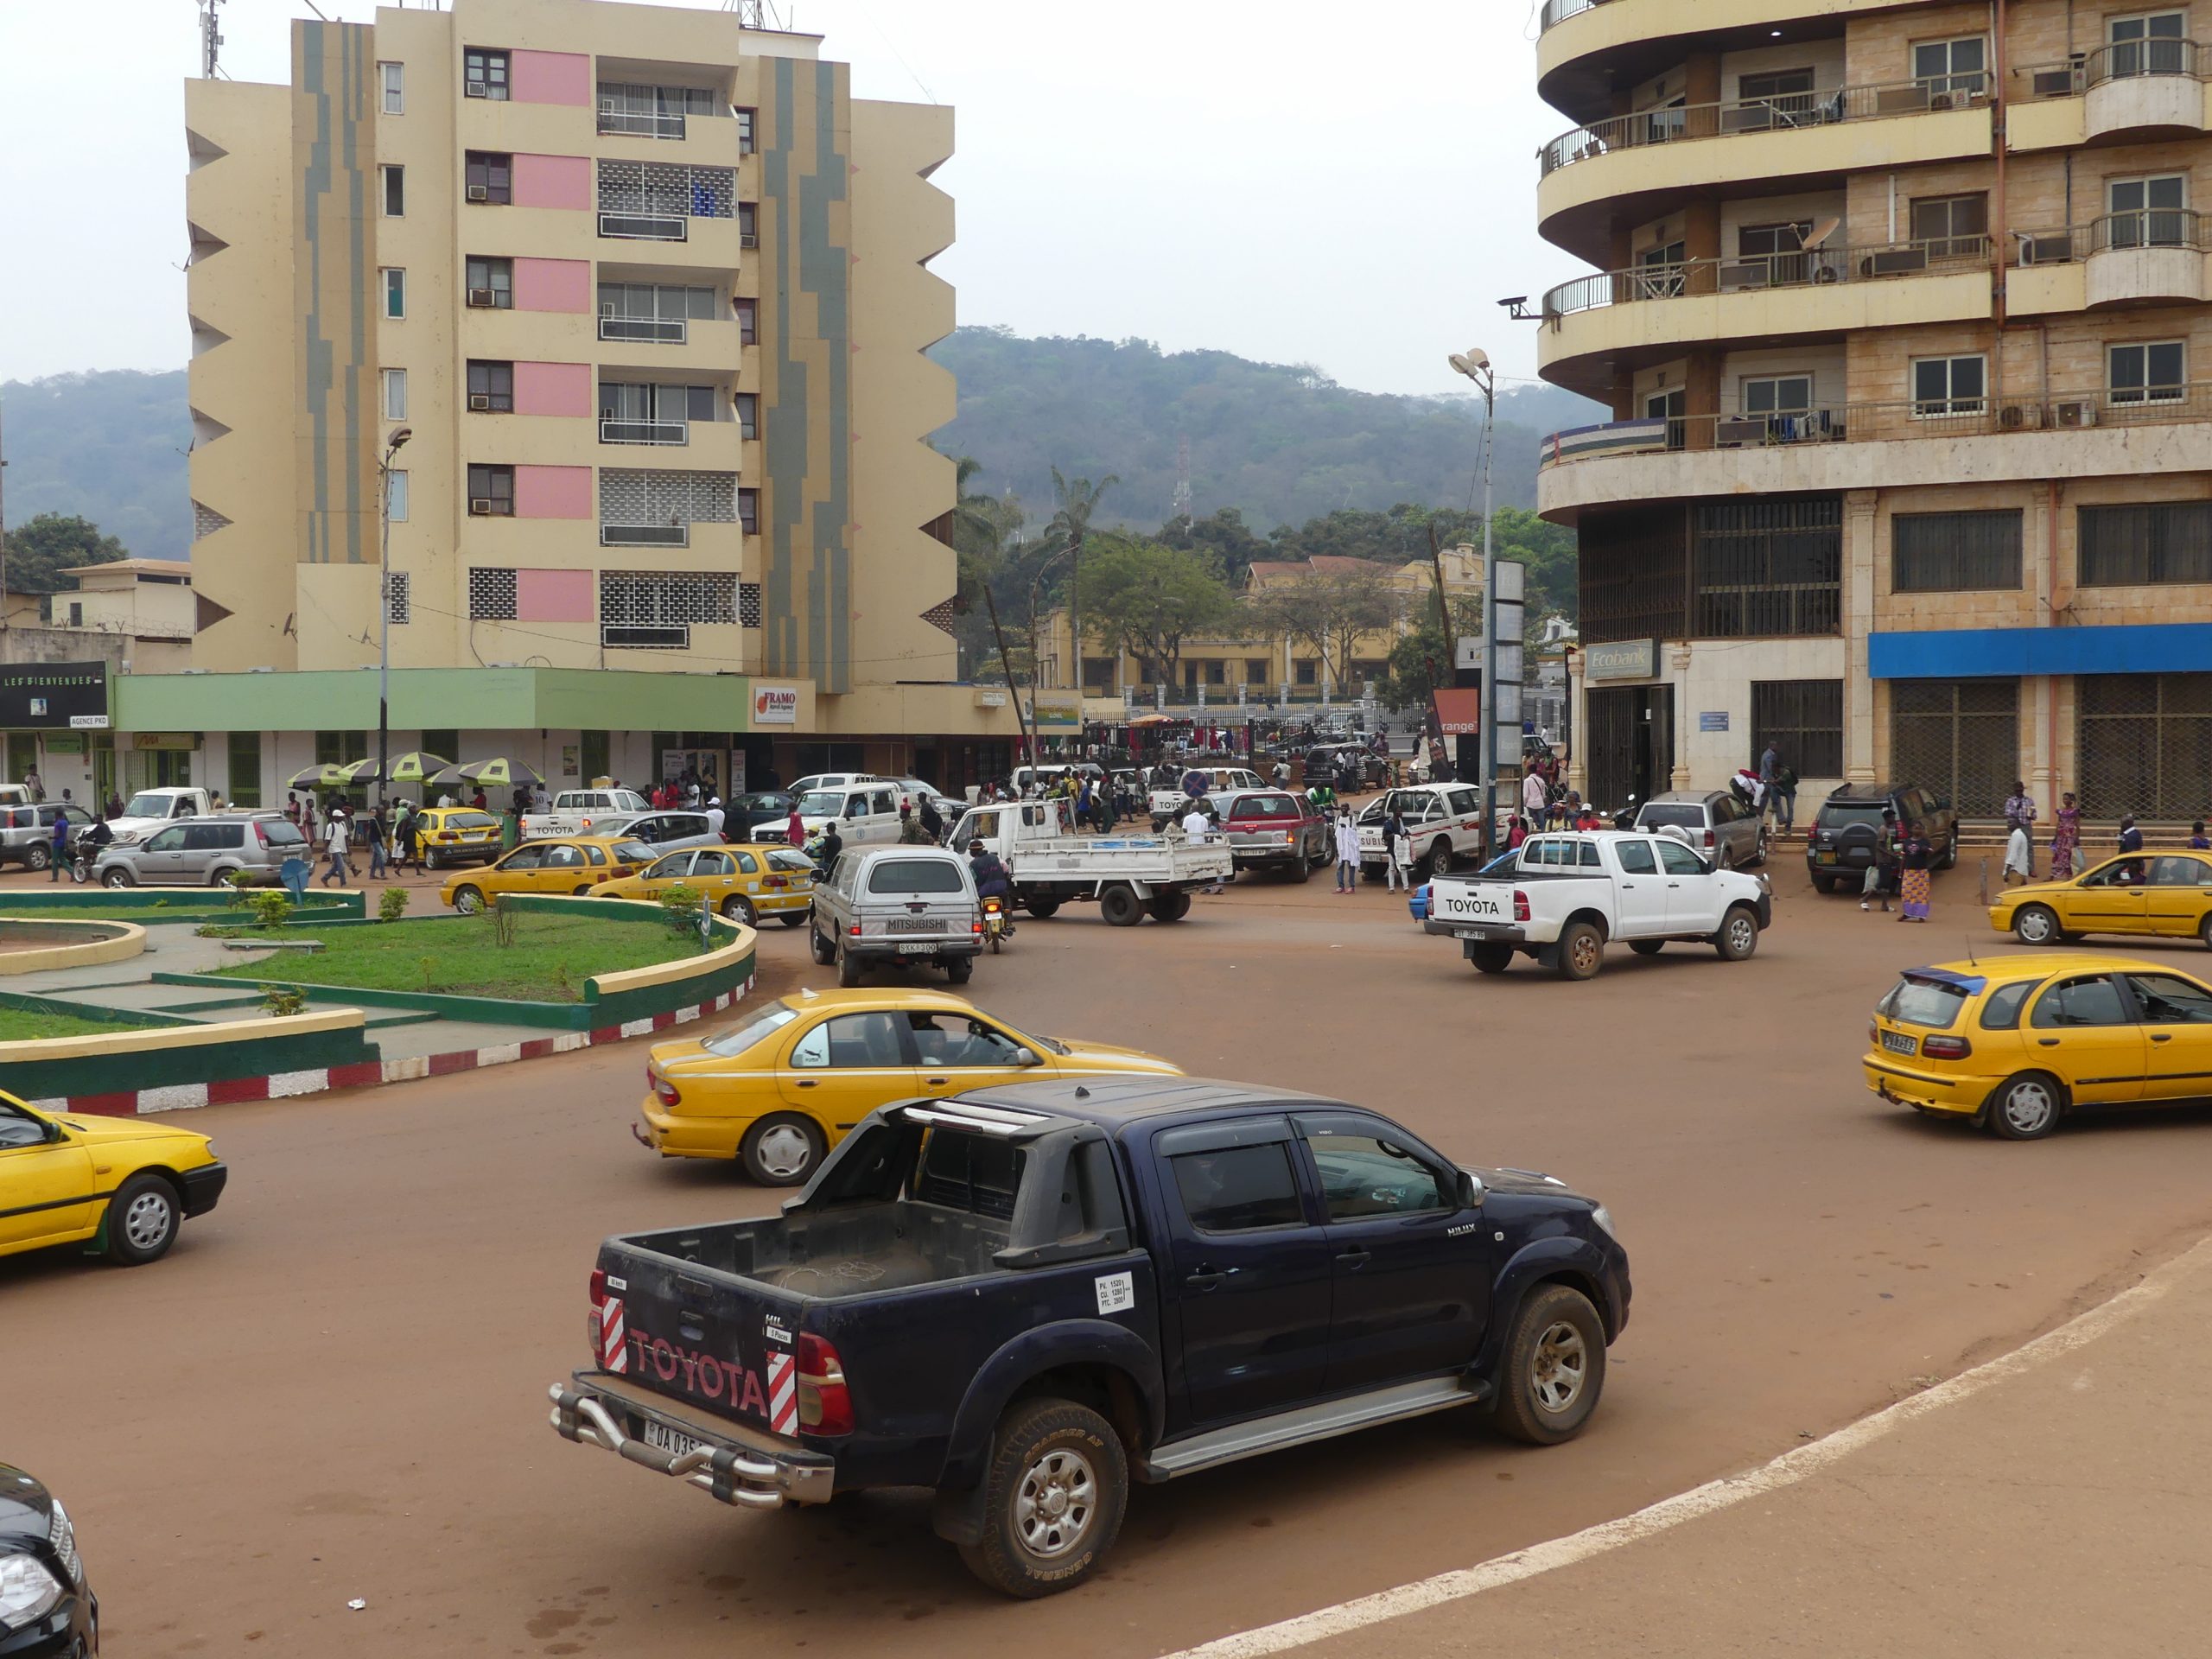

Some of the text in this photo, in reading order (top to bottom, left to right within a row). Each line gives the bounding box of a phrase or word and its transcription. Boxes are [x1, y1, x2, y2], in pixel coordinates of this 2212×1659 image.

[1592, 648, 1645, 668] Ecobank
[4, 677, 92, 687] LES BIENVENUES
[765, 692, 796, 704] FRAMO
[1442, 722, 1474, 734] range
[536, 795, 544, 804] 10
[1446, 899, 1499, 914] TOYOTA
[887, 919, 946, 930] MITSUBISHI
[1447, 1223, 1476, 1236] HILUX
[1110, 1279, 1122, 1287] 1520
[774, 1331, 789, 1342] Places
[629, 1327, 768, 1418] TOYOTA
[657, 1427, 702, 1456] DA 035
[1024, 1427, 1104, 1464] GRABBER AT
[1026, 1551, 1092, 1581] GENERAL
